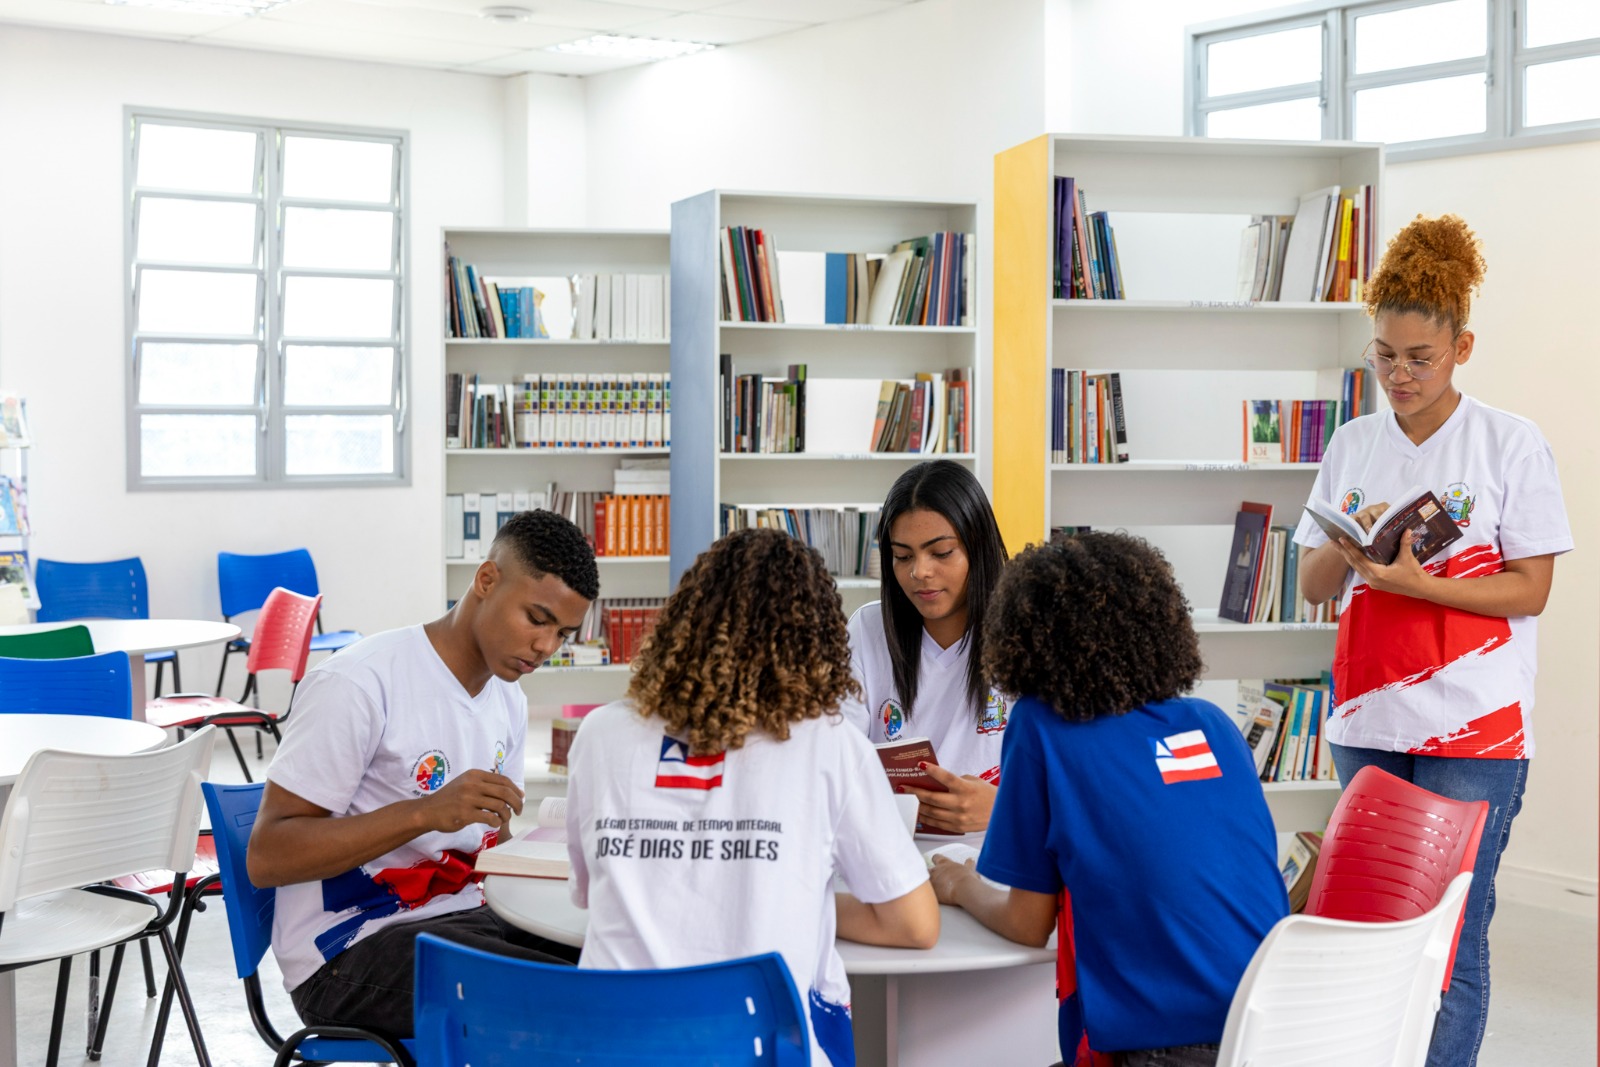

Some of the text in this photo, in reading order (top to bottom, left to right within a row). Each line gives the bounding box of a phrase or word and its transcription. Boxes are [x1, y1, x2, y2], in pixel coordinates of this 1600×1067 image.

[1203, 463, 1250, 472] EDUCAÇÃO
[629, 818, 679, 832] ESTADUAL
[683, 820, 695, 832] DE
[699, 819, 733, 832] TEMPO
[736, 819, 784, 834] INTEGRAL
[595, 834, 779, 861] JOSÉ DIAS DE SALES
